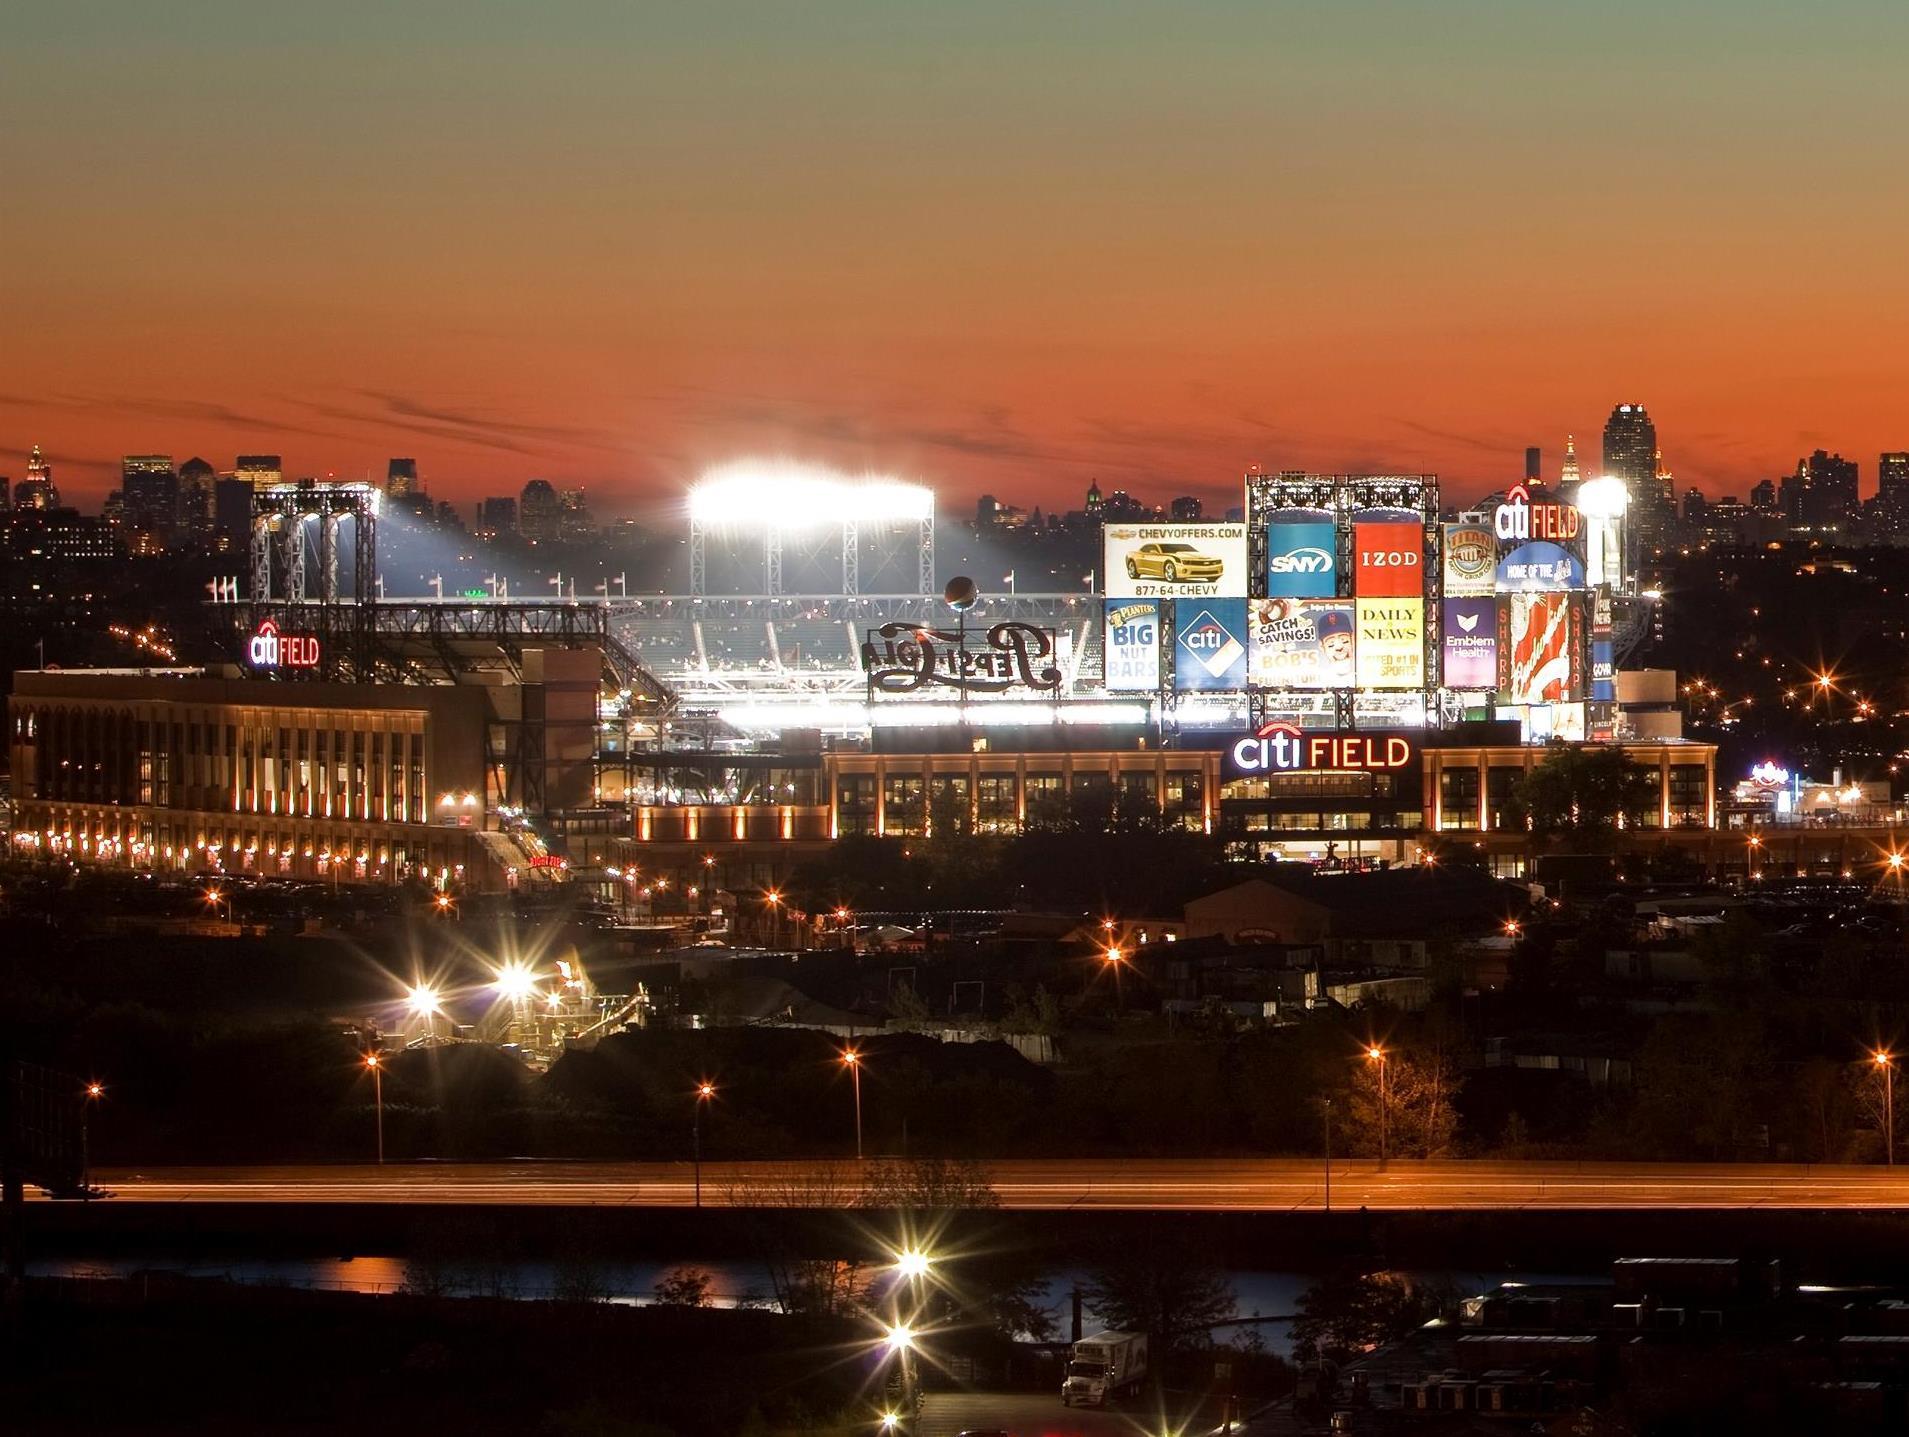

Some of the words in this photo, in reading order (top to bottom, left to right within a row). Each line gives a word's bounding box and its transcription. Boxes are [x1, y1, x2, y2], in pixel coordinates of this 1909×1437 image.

[1495, 496, 1529, 540] citi
[1532, 505, 1578, 538] FIELD
[1138, 528, 1243, 539] CHEVYOFFERS.COM
[1270, 556, 1324, 573] SNY
[1362, 552, 1418, 566] IZOD
[1507, 564, 1527, 578] HOME
[1528, 564, 1538, 578] OF
[1538, 564, 1553, 578] THE
[1135, 585, 1219, 596] 877-64-CHEVY
[1363, 609, 1416, 620] DAILY
[1260, 617, 1298, 635] CATCH
[1113, 624, 1153, 646] BIG
[1187, 628, 1221, 649] citi
[1258, 627, 1315, 645] SAVINGS!
[1363, 629, 1417, 640] NEWS
[1446, 635, 1495, 646] Emblem
[250, 630, 278, 665] citi
[279, 637, 319, 666] FIELD
[1120, 647, 1148, 659] NUT
[1452, 646, 1490, 658] Health
[1499, 608, 1507, 691] SHARP
[1108, 661, 1157, 677] BARS
[1233, 730, 1300, 770] citi
[1311, 738, 1410, 767] FIELD
